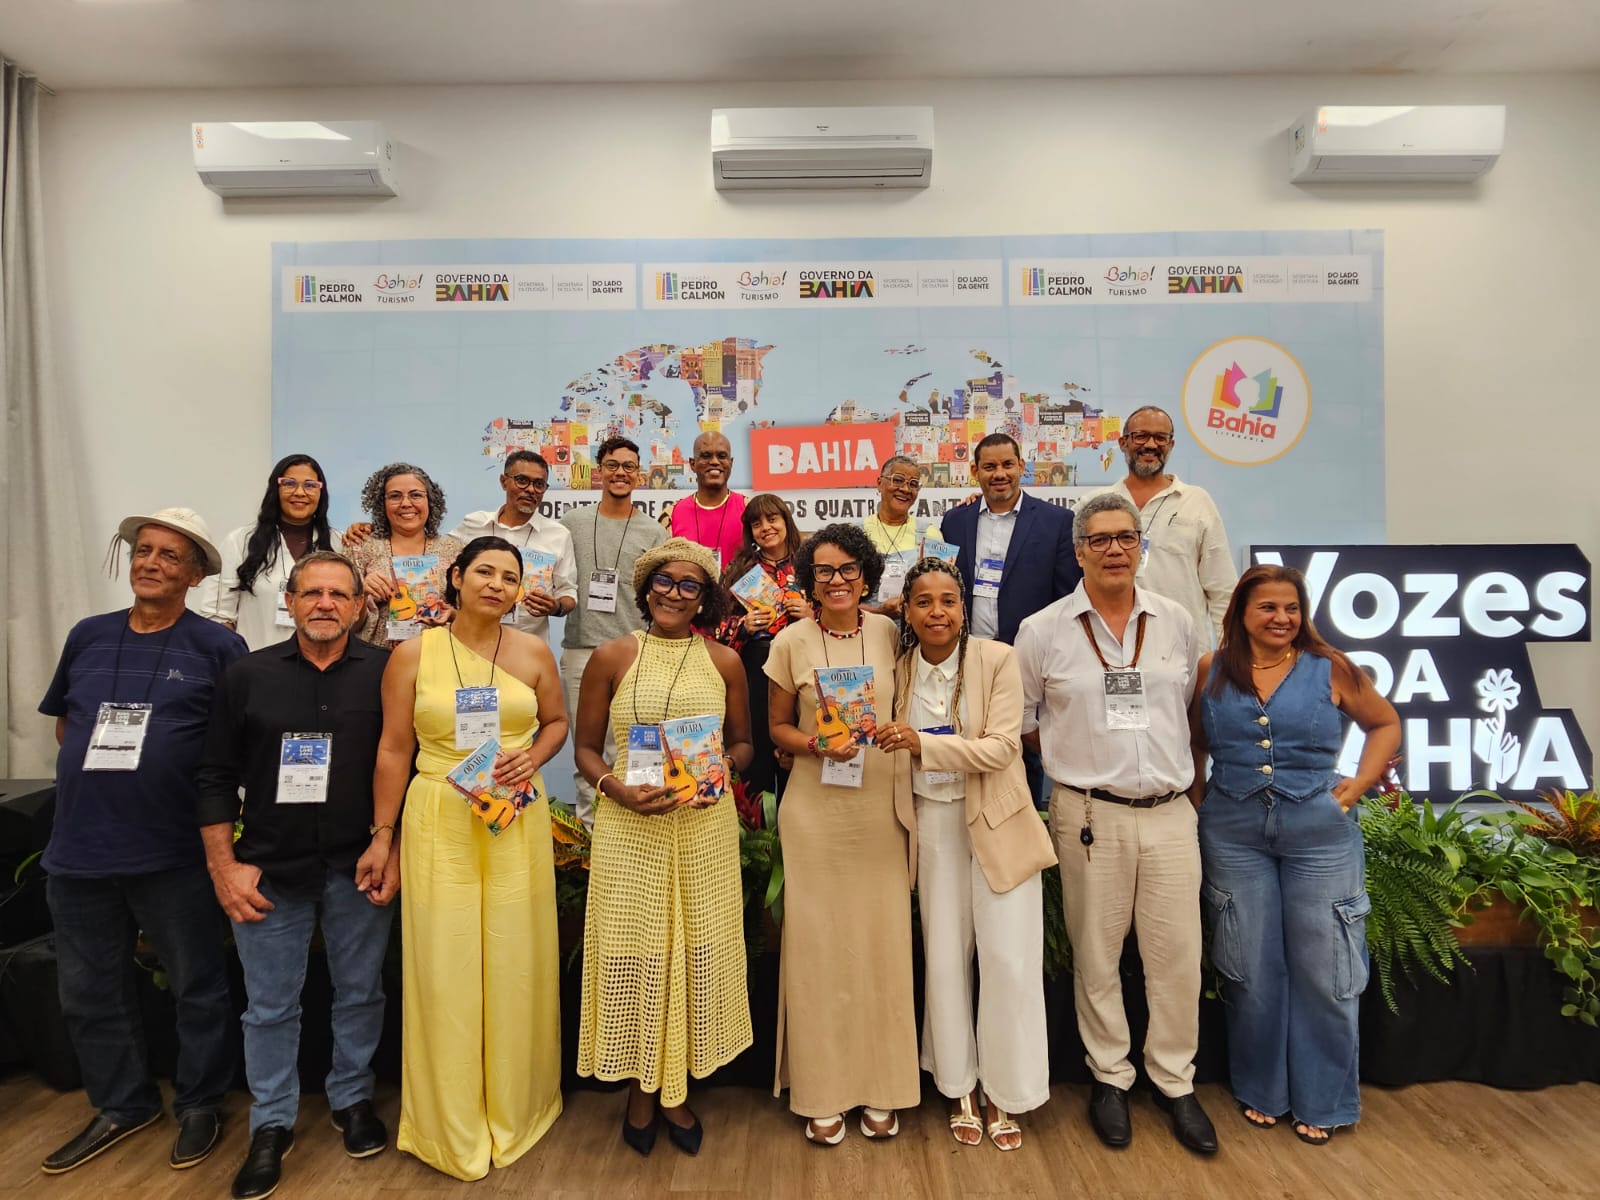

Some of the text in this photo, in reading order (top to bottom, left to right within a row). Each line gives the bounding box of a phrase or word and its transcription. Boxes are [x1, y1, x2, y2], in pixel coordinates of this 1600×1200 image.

[800, 271, 873, 280] GOVERNO DA
[1103, 265, 1156, 282] Bahia!
[1168, 266, 1243, 275] GOVERNO DA
[374, 273, 423, 290] Bahia!
[436, 274, 509, 283] GOVERNO DA
[736, 270, 788, 287] Bahia!
[1048, 276, 1085, 285] PEDRO
[320, 284, 355, 293] PEDRO
[681, 281, 718, 290] PEDRO
[800, 281, 874, 298] BAHIA
[1168, 276, 1243, 294] BAHIA
[436, 284, 510, 302] BAHIA
[681, 291, 725, 300] CALMON
[740, 292, 779, 301] TURISMO
[1048, 287, 1093, 296] CALMON
[1107, 288, 1147, 297] TURISMO
[320, 294, 362, 303] CALMON
[377, 295, 415, 304] TURISMO
[1207, 408, 1276, 439] Bahia
[768, 439, 879, 475] BAHIA
[815, 500, 881, 520] QUATR
[1255, 551, 1588, 639] Vozes
[830, 672, 857, 682] ODARA
[676, 723, 703, 735] ODARA
[463, 753, 488, 775] ODARA
